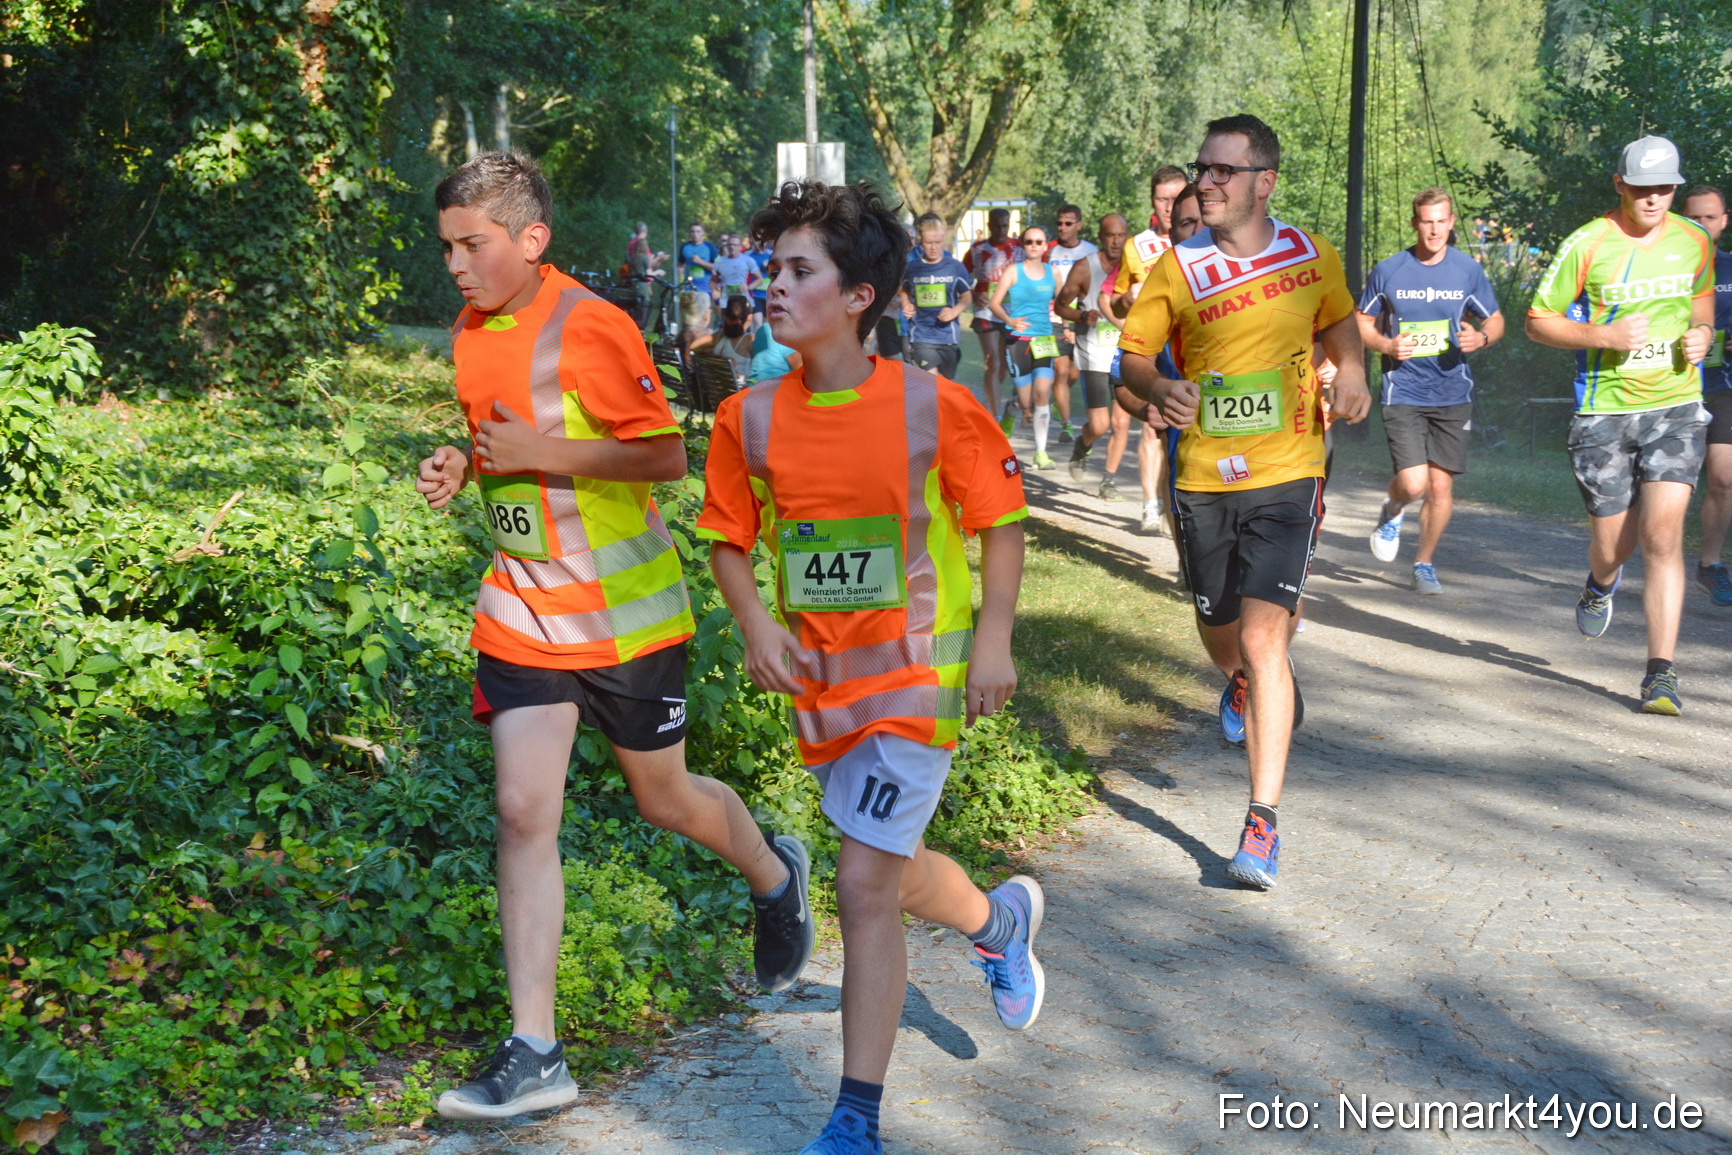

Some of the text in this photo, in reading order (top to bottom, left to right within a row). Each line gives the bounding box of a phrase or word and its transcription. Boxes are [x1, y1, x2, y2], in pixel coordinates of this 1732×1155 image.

[1396, 289, 1464, 300] EURO POLES
[1602, 274, 1694, 304] BOCK
[922, 292, 939, 300] 492
[1197, 268, 1322, 326] MAX BÖGL
[1411, 334, 1438, 347] 523
[1209, 393, 1272, 418] 1204
[791, 534, 831, 543] firmenlauf
[836, 539, 859, 548] 2018
[804, 551, 872, 586] 447
[802, 585, 882, 596] Weinzierl Samuel
[856, 774, 901, 823] 10
